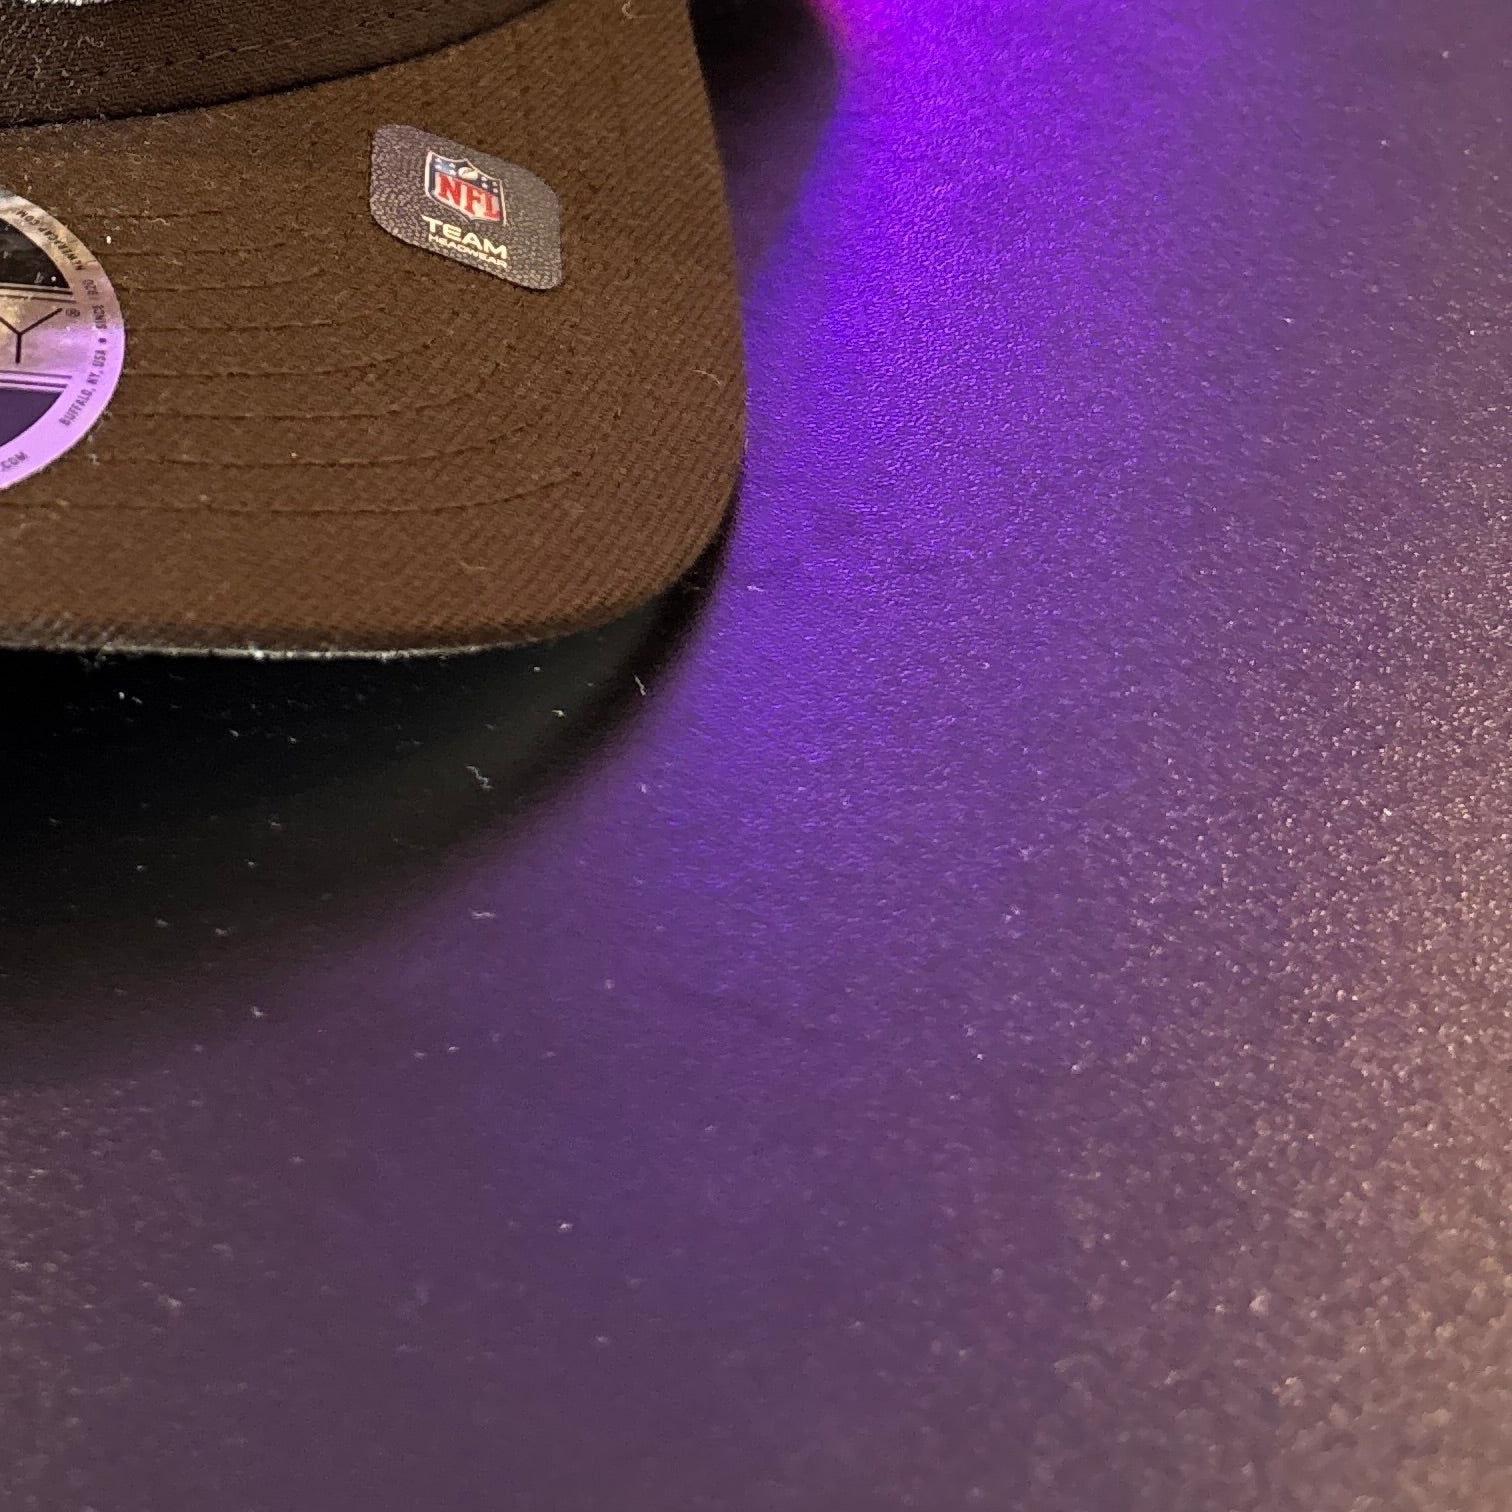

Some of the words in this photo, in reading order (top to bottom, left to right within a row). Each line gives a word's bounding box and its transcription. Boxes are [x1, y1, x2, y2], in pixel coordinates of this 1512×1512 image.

[437, 173, 502, 221] NFL
[421, 214, 508, 260] TEAM
[428, 235, 508, 269] HEADWEAR
[59, 388, 97, 426] BUFFALO,
[92, 349, 107, 368] USA
